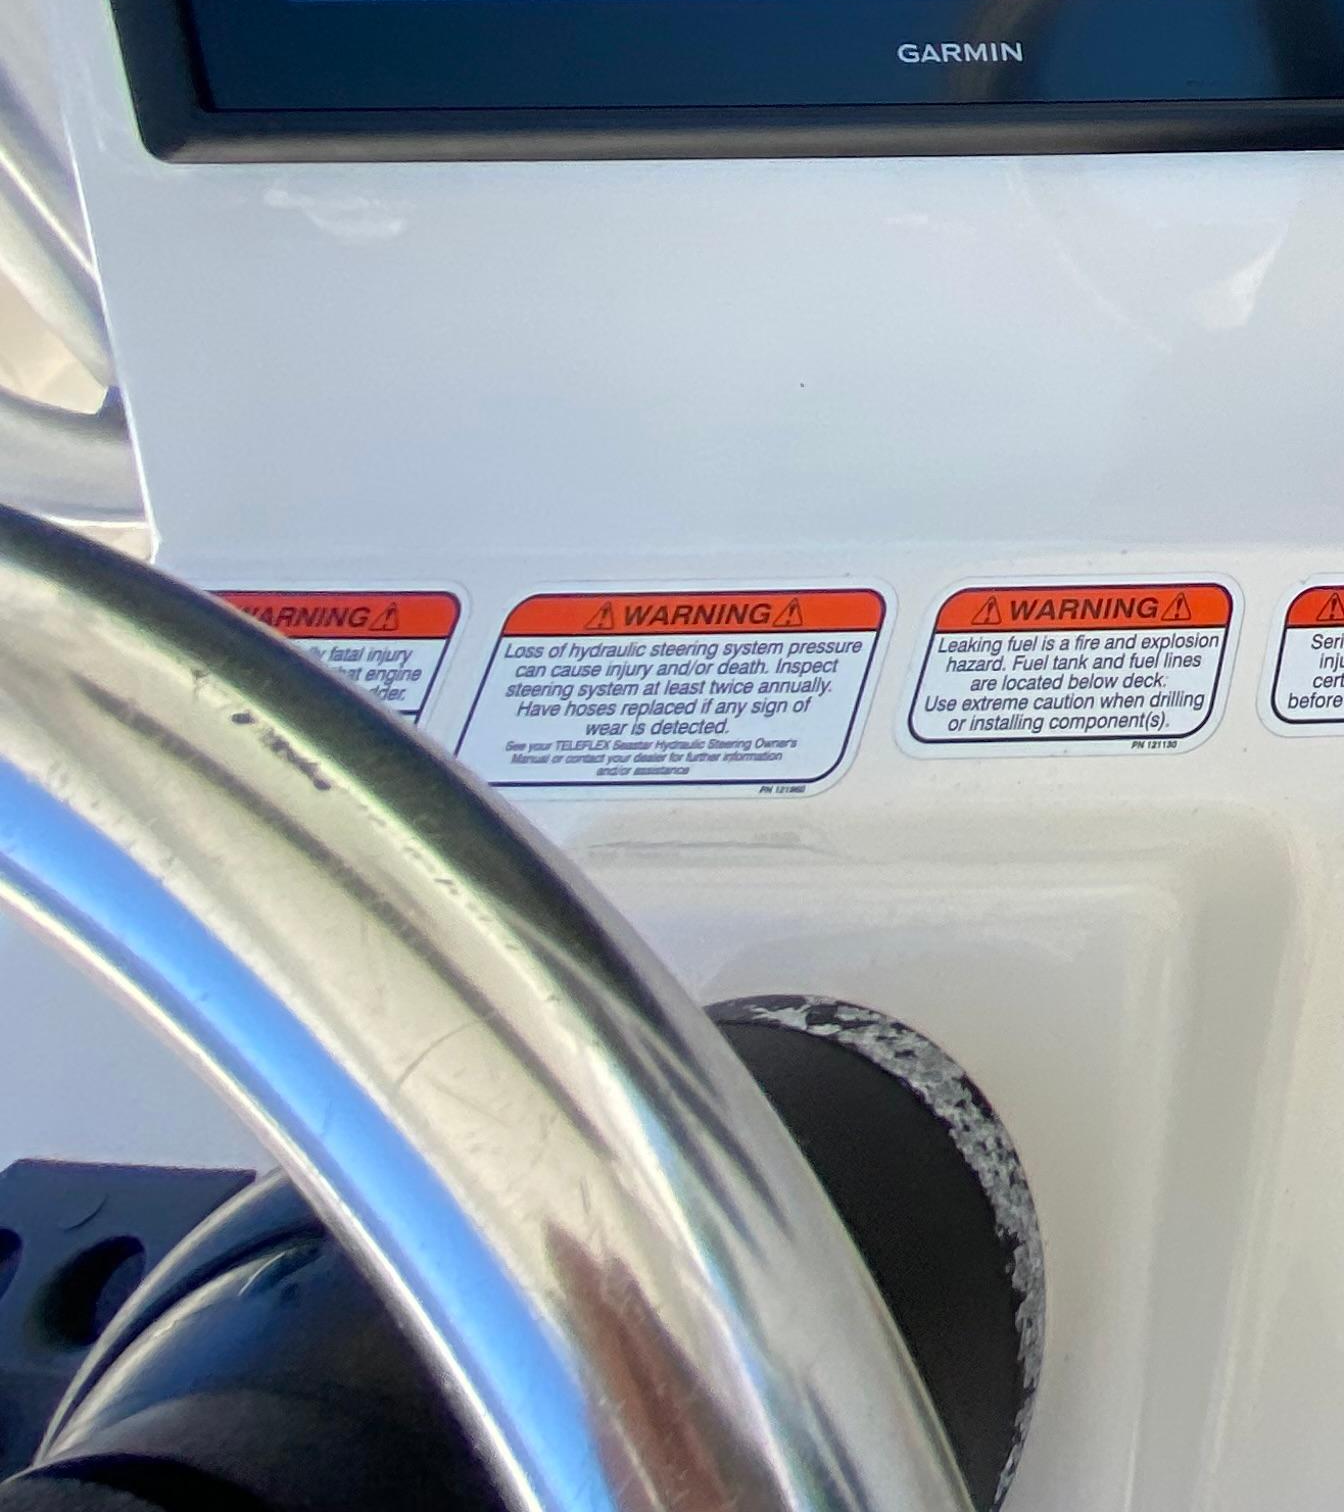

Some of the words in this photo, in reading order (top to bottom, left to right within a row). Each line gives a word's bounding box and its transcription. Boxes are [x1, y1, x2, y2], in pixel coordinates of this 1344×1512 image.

[897, 41, 1024, 64] GARMIN
[625, 604, 771, 625] WARNING
[1010, 597, 1159, 621] WARNING
[504, 643, 544, 658] Loss
[549, 643, 568, 657] of
[570, 641, 647, 662] hydraulic
[651, 641, 717, 661] steering
[722, 641, 783, 663] system
[787, 639, 862, 661] pressure
[938, 637, 1001, 656] Leaking
[1007, 636, 1037, 651] fuel
[1042, 636, 1054, 651] is
[1059, 639, 1069, 651] a
[1074, 635, 1101, 650] fire
[1104, 634, 1136, 649] and
[1141, 633, 1218, 655] explosion
[946, 656, 1006, 672] hazard.
[1012, 655, 1048, 671] Fuel
[1053, 655, 1088, 670] tank
[1092, 654, 1125, 669] and
[1129, 653, 1160, 669] fuel
[1164, 652, 1201, 668] lines
[970, 678, 997, 692] are
[1002, 675, 1062, 690] located
[1068, 674, 1118, 689] below
[1123, 672, 1166, 689] deck.
[926, 696, 955, 712] Use
[961, 695, 1028, 711] extreme
[1034, 694, 1094, 710] caution
[1100, 693, 1144, 709] when
[1149, 692, 1204, 710] drilling
[1288, 692, 1343, 709] before
[948, 717, 967, 732] or
[969, 714, 1043, 733] installing
[1050, 712, 1169, 733] component(s).
